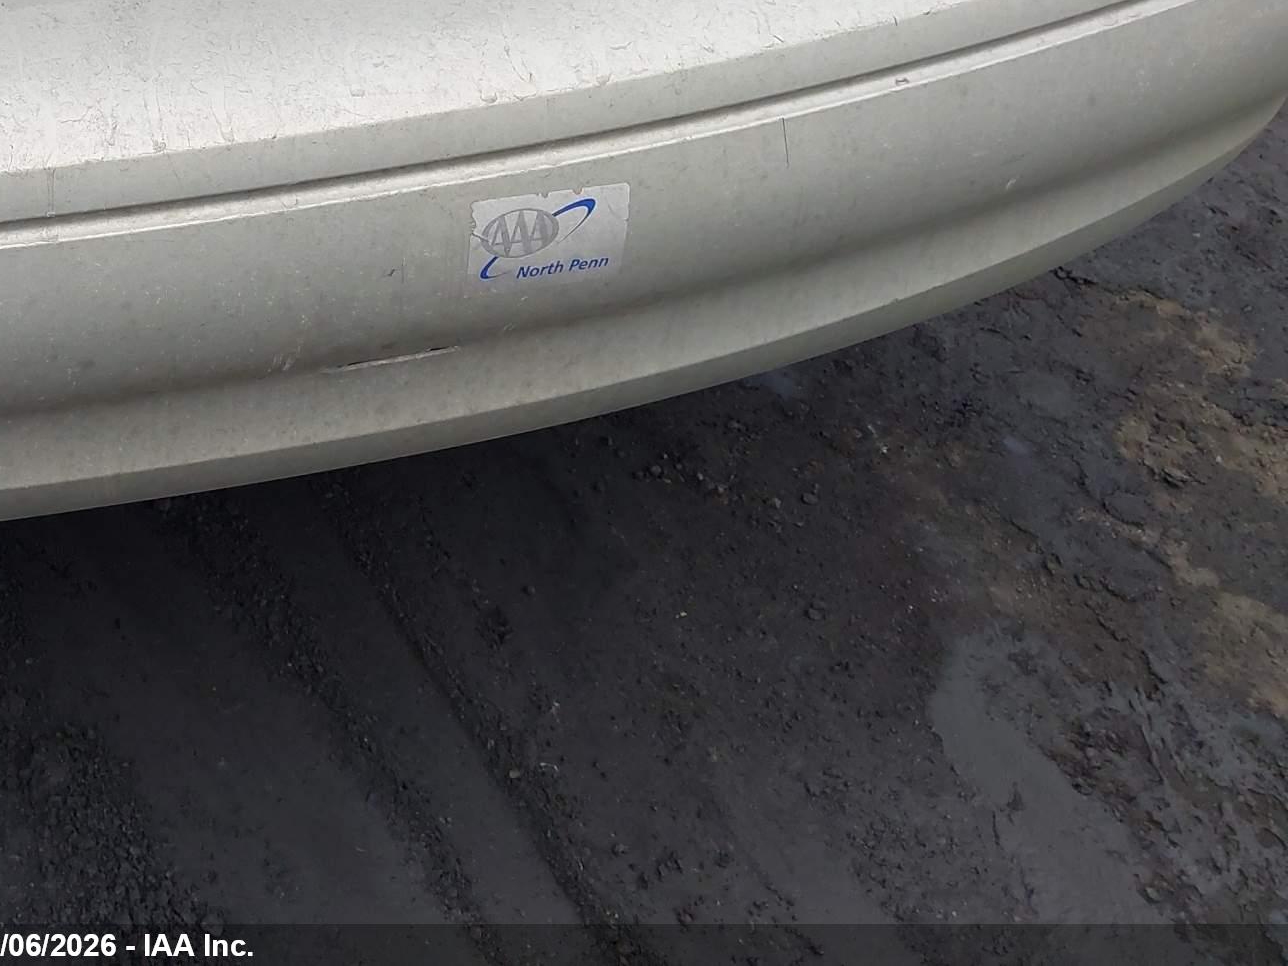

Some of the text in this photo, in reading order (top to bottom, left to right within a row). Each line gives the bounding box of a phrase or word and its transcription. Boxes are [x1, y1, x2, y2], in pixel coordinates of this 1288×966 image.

[488, 210, 554, 258] AAA
[516, 256, 609, 279] North Penn
